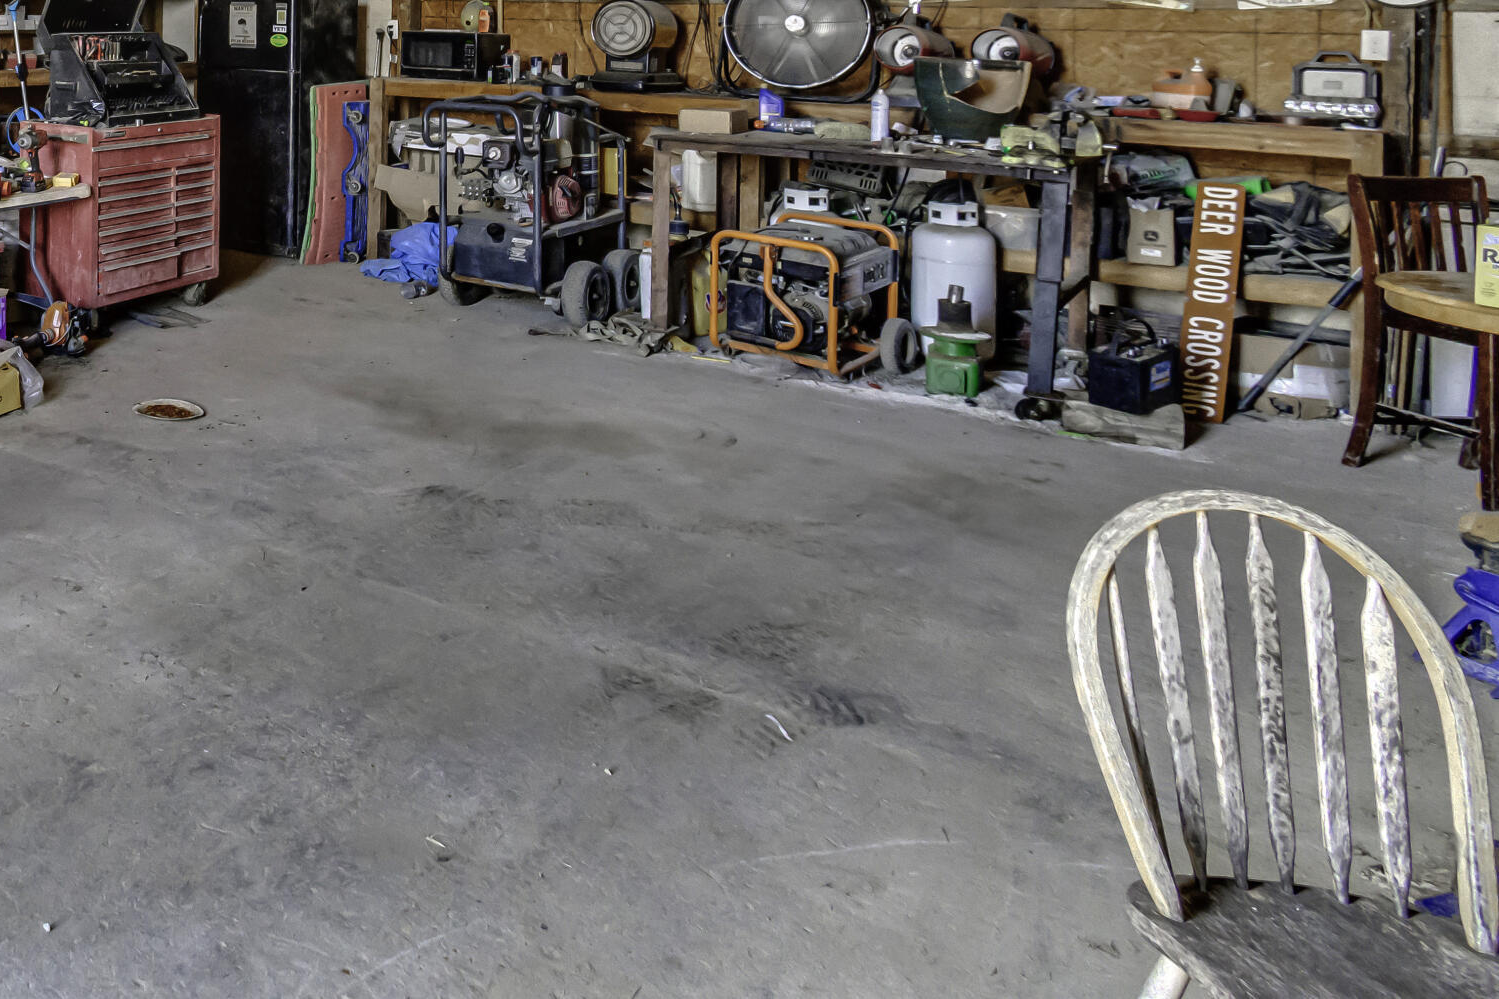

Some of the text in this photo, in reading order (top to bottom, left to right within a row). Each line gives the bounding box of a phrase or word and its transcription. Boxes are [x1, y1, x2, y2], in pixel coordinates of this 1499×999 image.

[1199, 186, 1239, 237] DEER
[1192, 248, 1233, 304] WOOD
[1181, 316, 1225, 418] CROSSING
